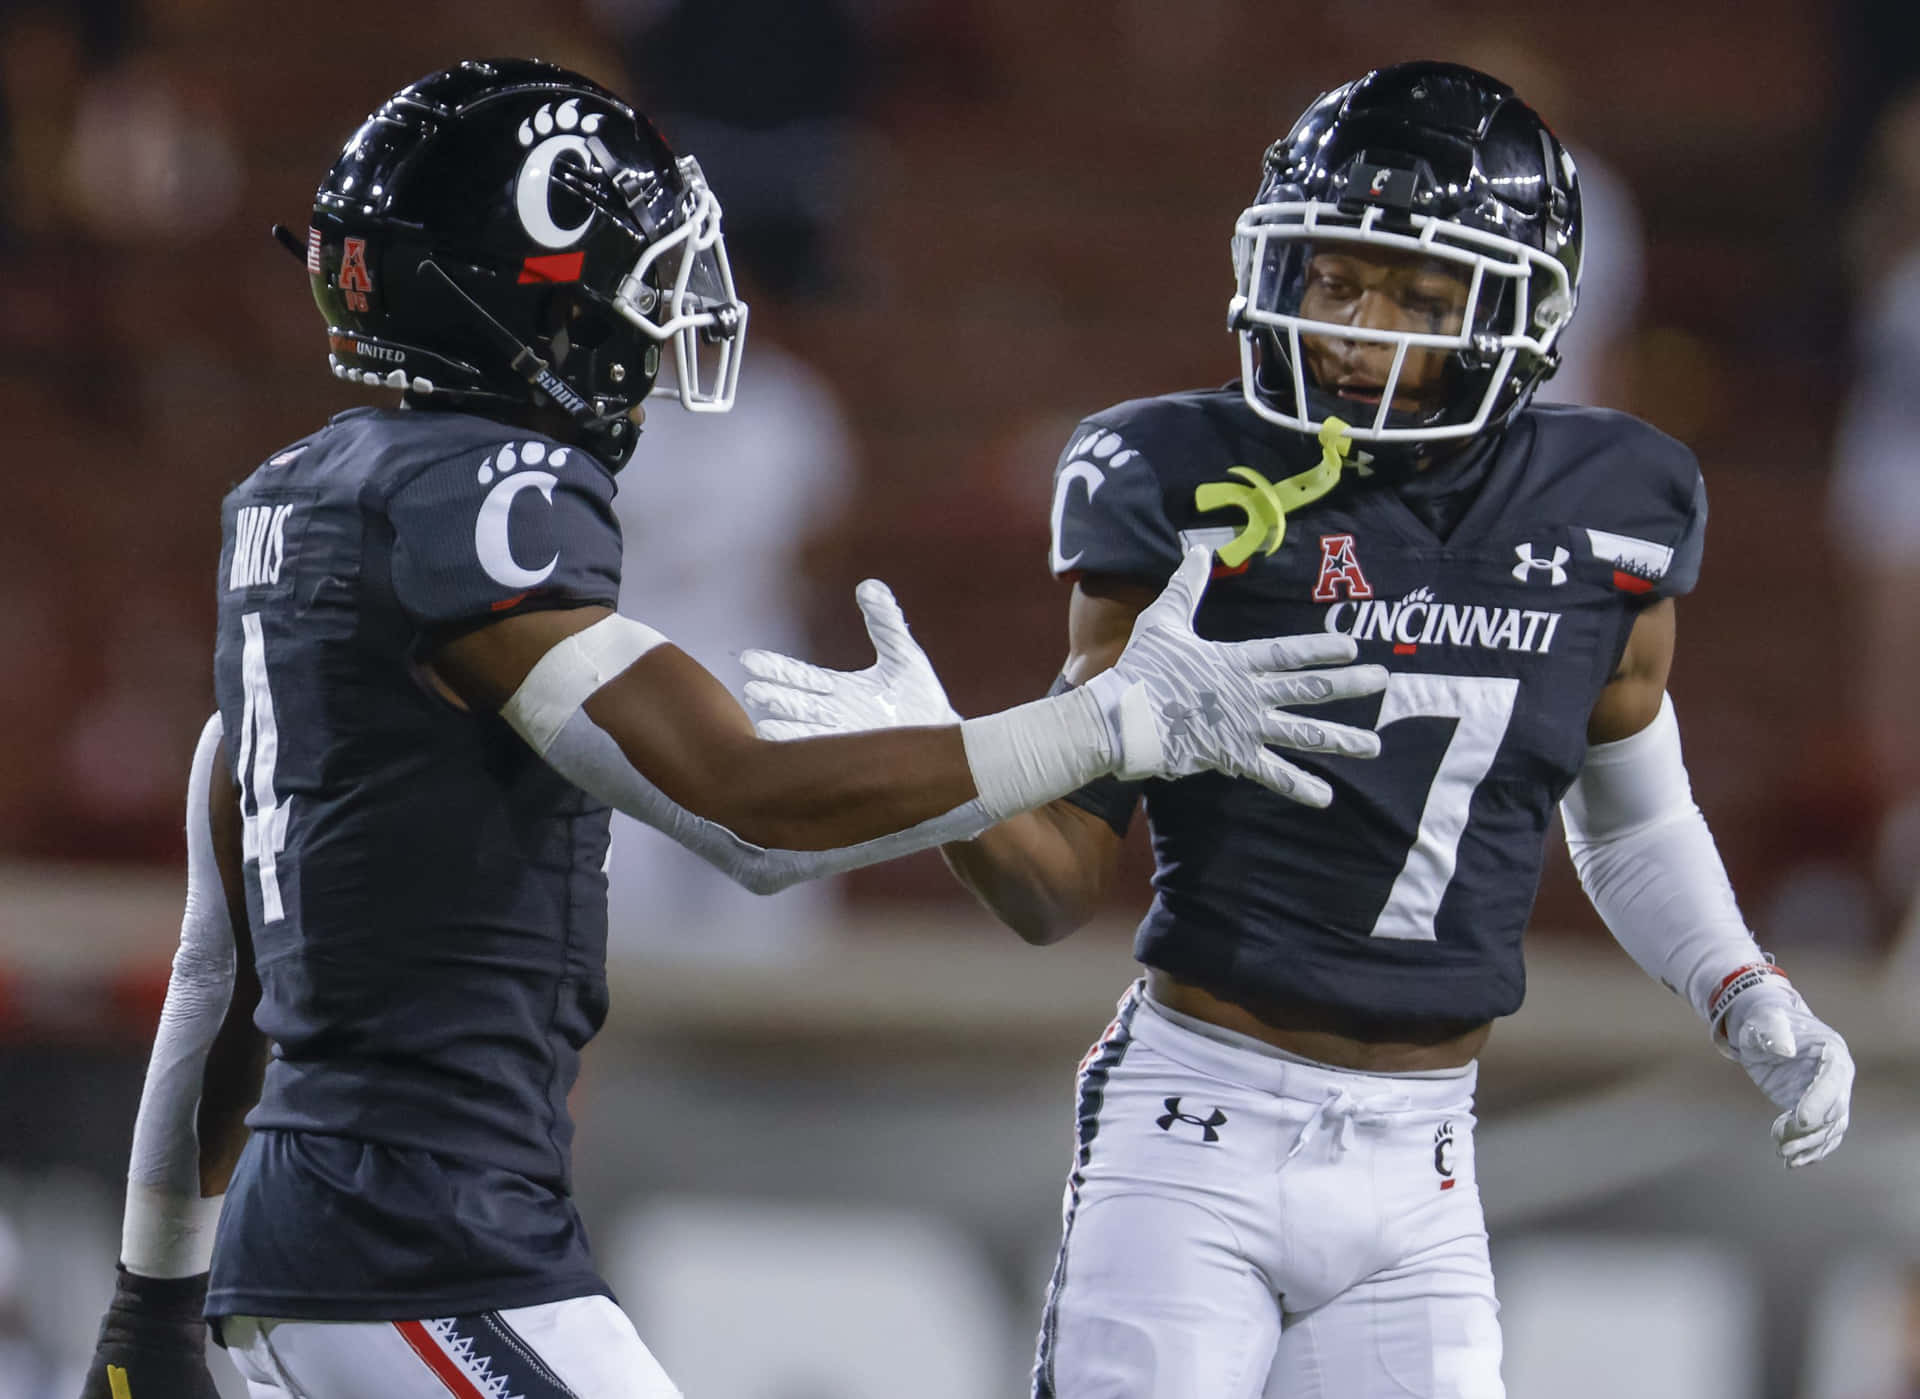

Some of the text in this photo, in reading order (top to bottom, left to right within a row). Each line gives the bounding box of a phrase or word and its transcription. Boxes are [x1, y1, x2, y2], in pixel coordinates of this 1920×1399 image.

[516, 133, 598, 249] C
[357, 341, 406, 363] UNITED
[475, 470, 560, 589] C
[1313, 534, 1373, 602] A
[1324, 596, 1562, 653] CINCINNATI
[236, 611, 294, 925] 4
[1370, 672, 1520, 941] 7
